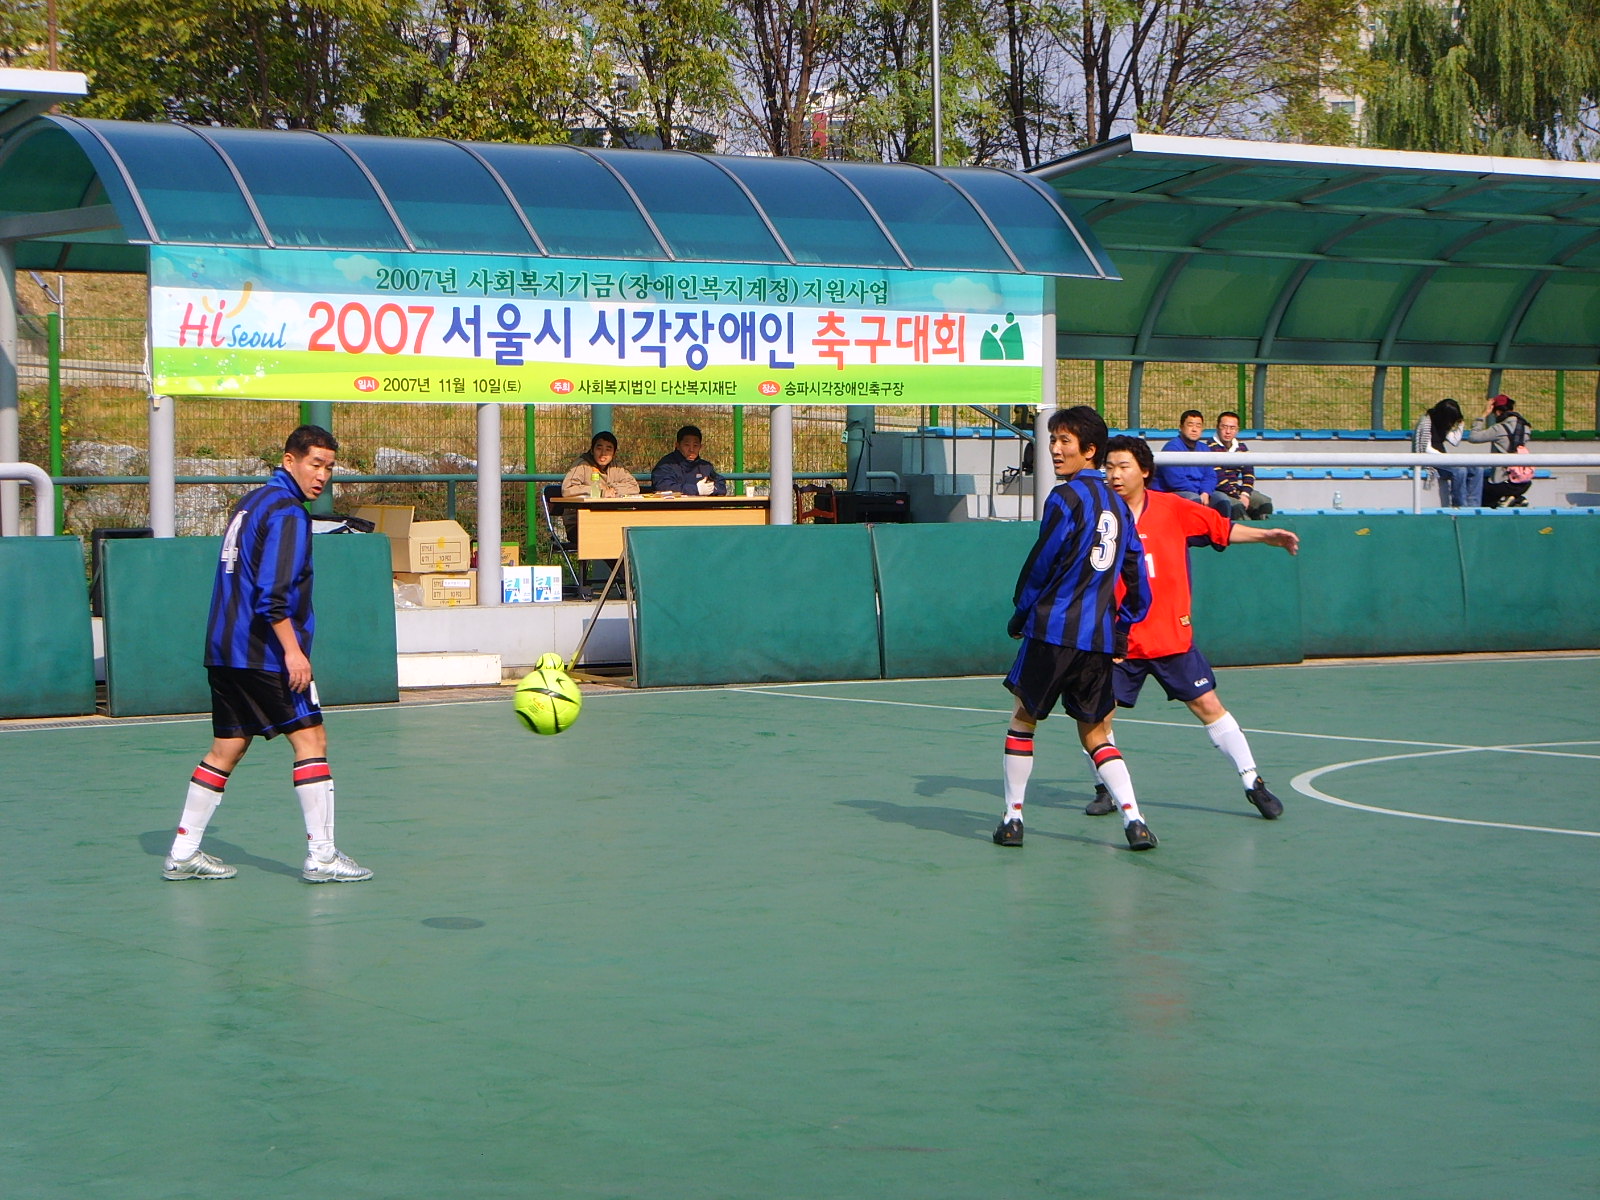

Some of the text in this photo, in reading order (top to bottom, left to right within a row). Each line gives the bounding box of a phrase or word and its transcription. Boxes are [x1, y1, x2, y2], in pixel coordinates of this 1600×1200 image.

[376, 267, 458, 294] 2007년
[179, 299, 287, 349] Hi Seoul
[308, 300, 966, 372] 2007 서울시 시각장애인 축구대회
[357, 377, 522, 394] 일시 2007년 11월 10일(토)
[578, 379, 657, 396] 사회복지법인
[661, 380, 738, 396] 다산복지재단
[761, 380, 905, 397] 장소 송파시각장애인축구장
[221, 509, 248, 574] 4
[1089, 510, 1120, 573] 3
